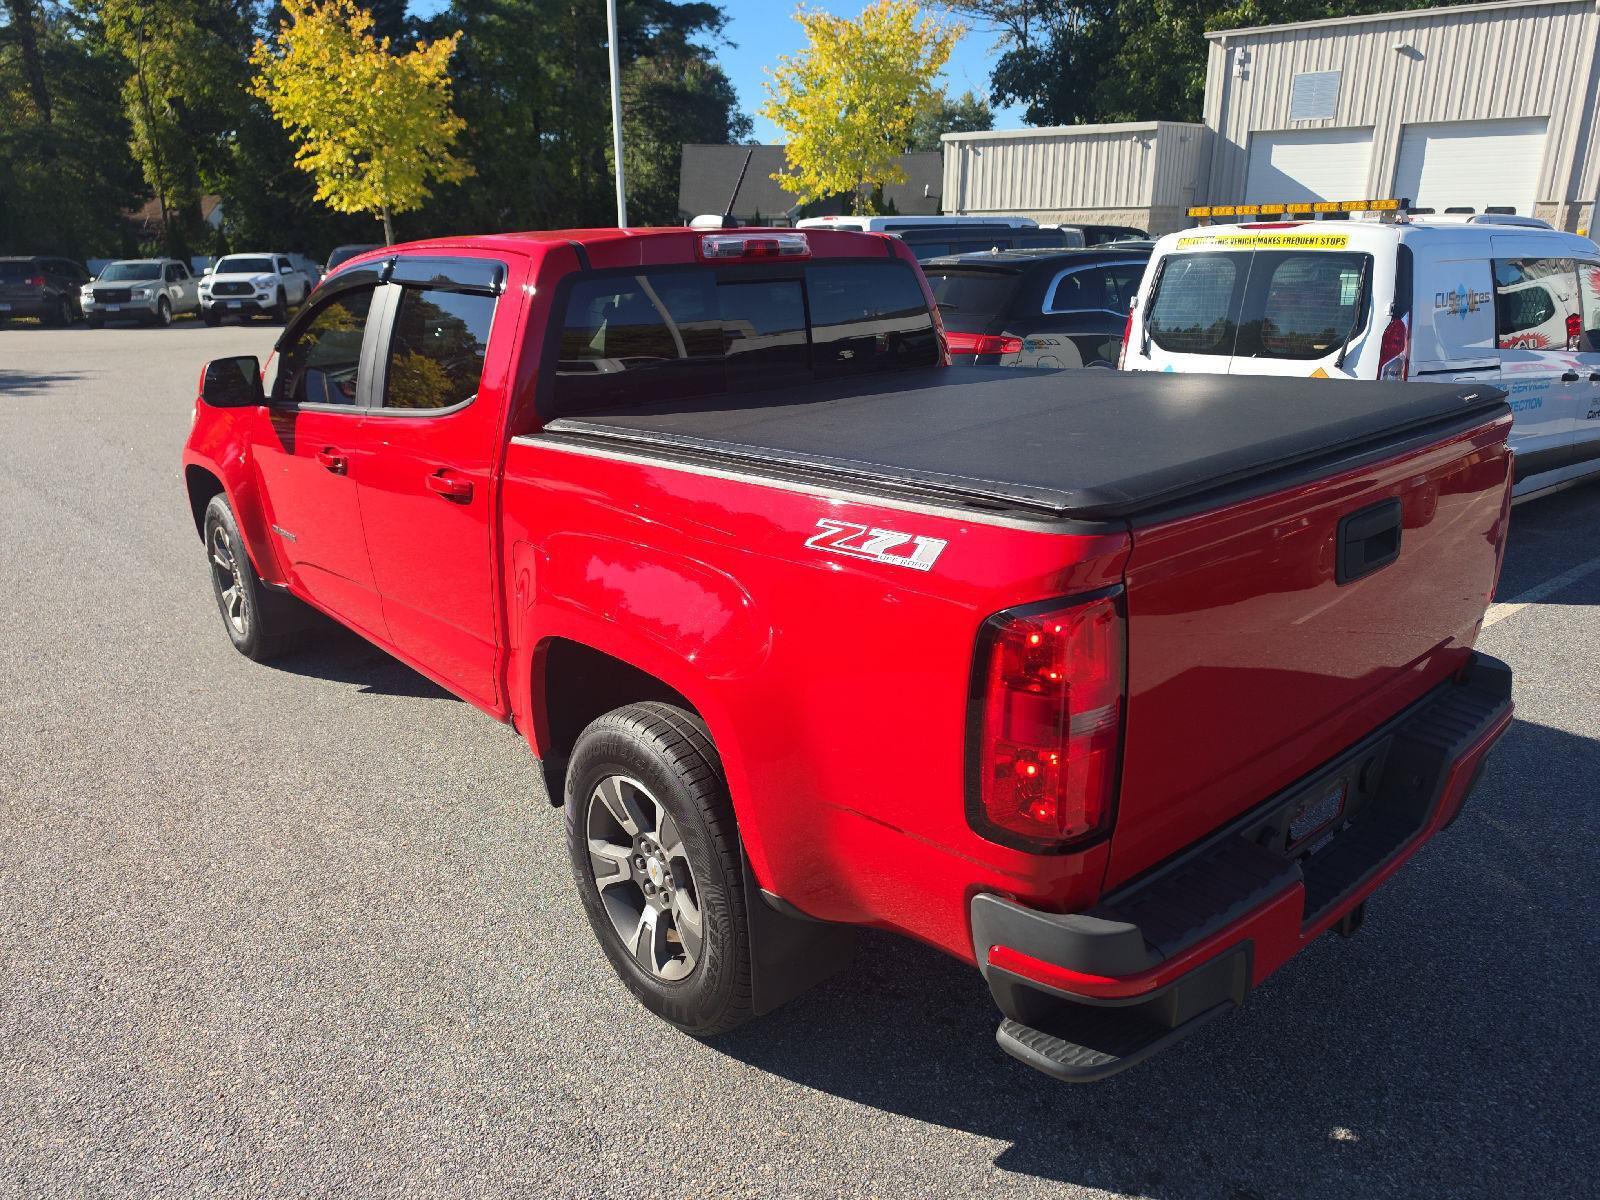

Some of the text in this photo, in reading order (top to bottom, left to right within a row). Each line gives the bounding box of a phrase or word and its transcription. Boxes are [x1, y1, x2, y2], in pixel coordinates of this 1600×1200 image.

[1257, 236, 1281, 246] MAKES
[1282, 236, 1318, 246] FREQUENT
[1320, 236, 1346, 246] STOPS
[804, 518, 949, 572] Z71
